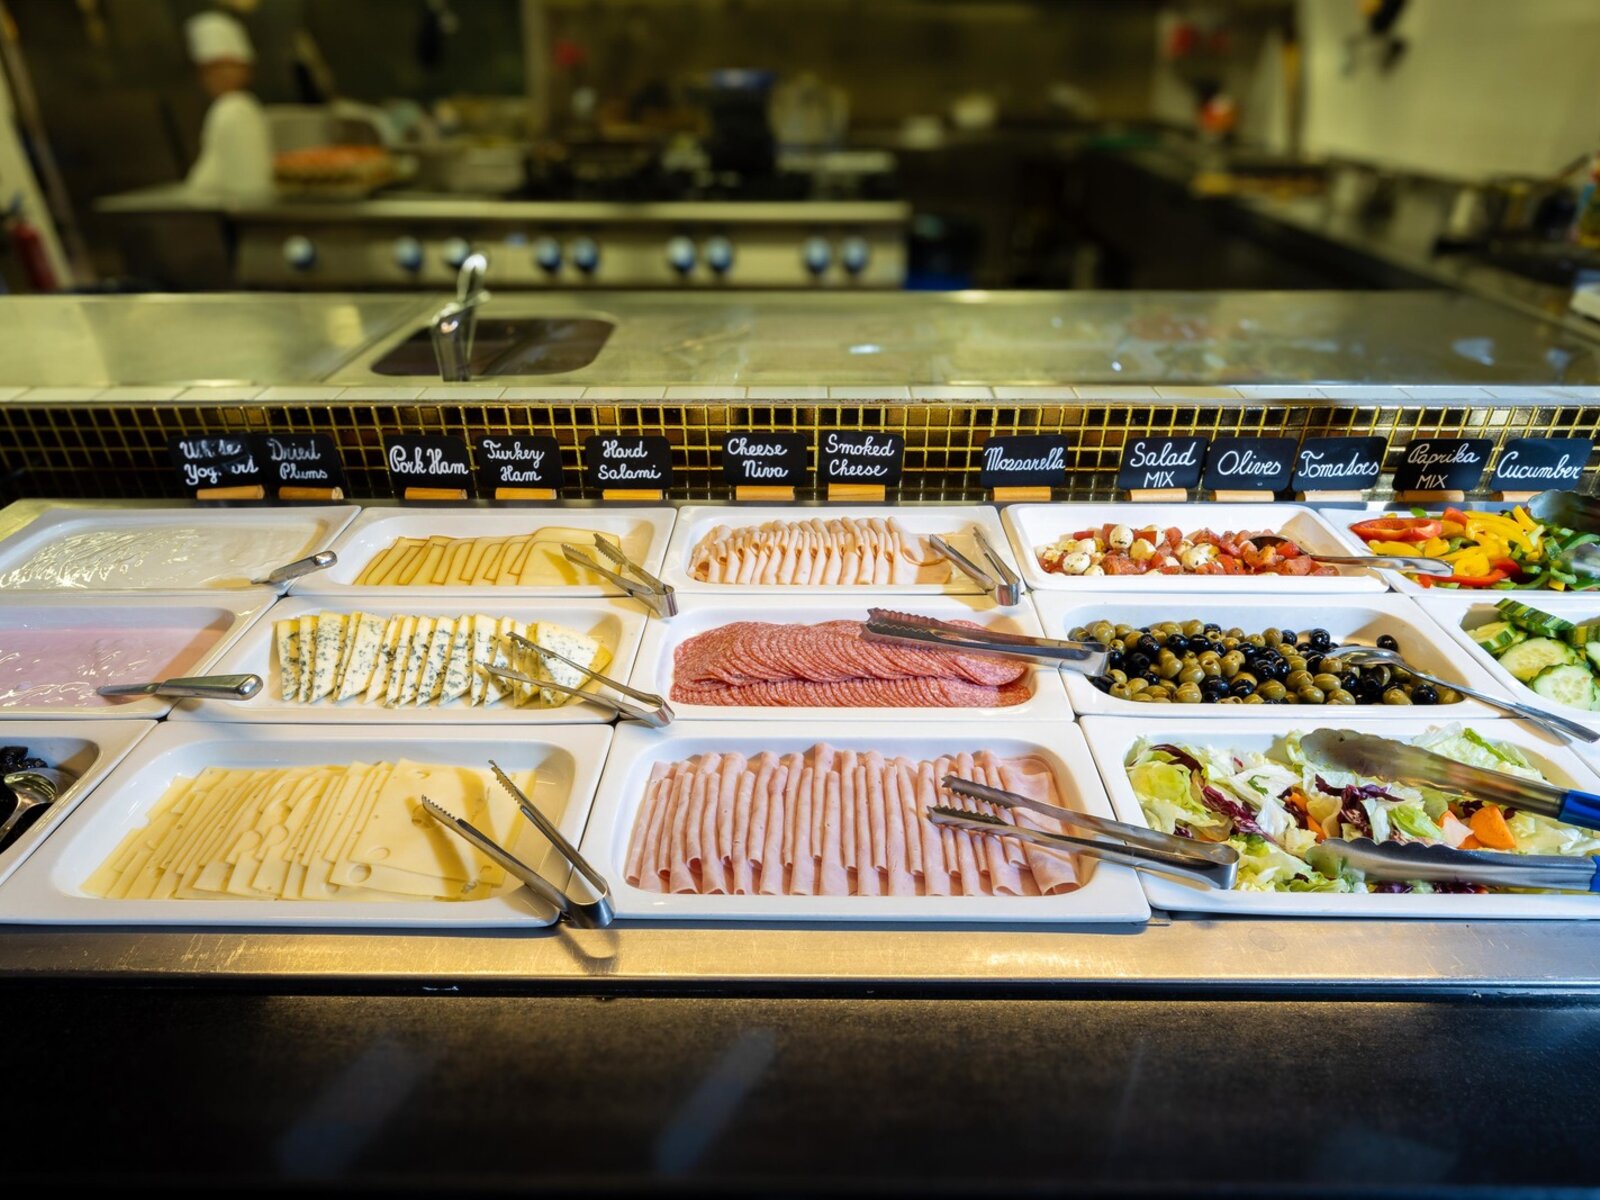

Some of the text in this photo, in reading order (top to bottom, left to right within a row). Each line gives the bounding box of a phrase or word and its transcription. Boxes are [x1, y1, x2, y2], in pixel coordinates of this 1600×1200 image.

[267, 438, 320, 461] Dried
[483, 439, 545, 469] Turkey
[602, 440, 648, 458] Hard
[727, 437, 788, 456] Cheese
[825, 433, 895, 457] Smoked
[1130, 441, 1197, 467] Salad
[389, 445, 469, 475] Pork Ham
[1217, 450, 1282, 476] Olives
[1407, 442, 1480, 472] Paprika
[1496, 450, 1583, 480] Cucumber
[280, 462, 328, 480] Plums
[500, 465, 542, 482] Ham
[598, 463, 662, 480] Salami
[742, 460, 789, 478] Niva
[829, 458, 888, 477] Cheese
[1143, 470, 1175, 488] MIX
[1415, 474, 1449, 489] MIX
